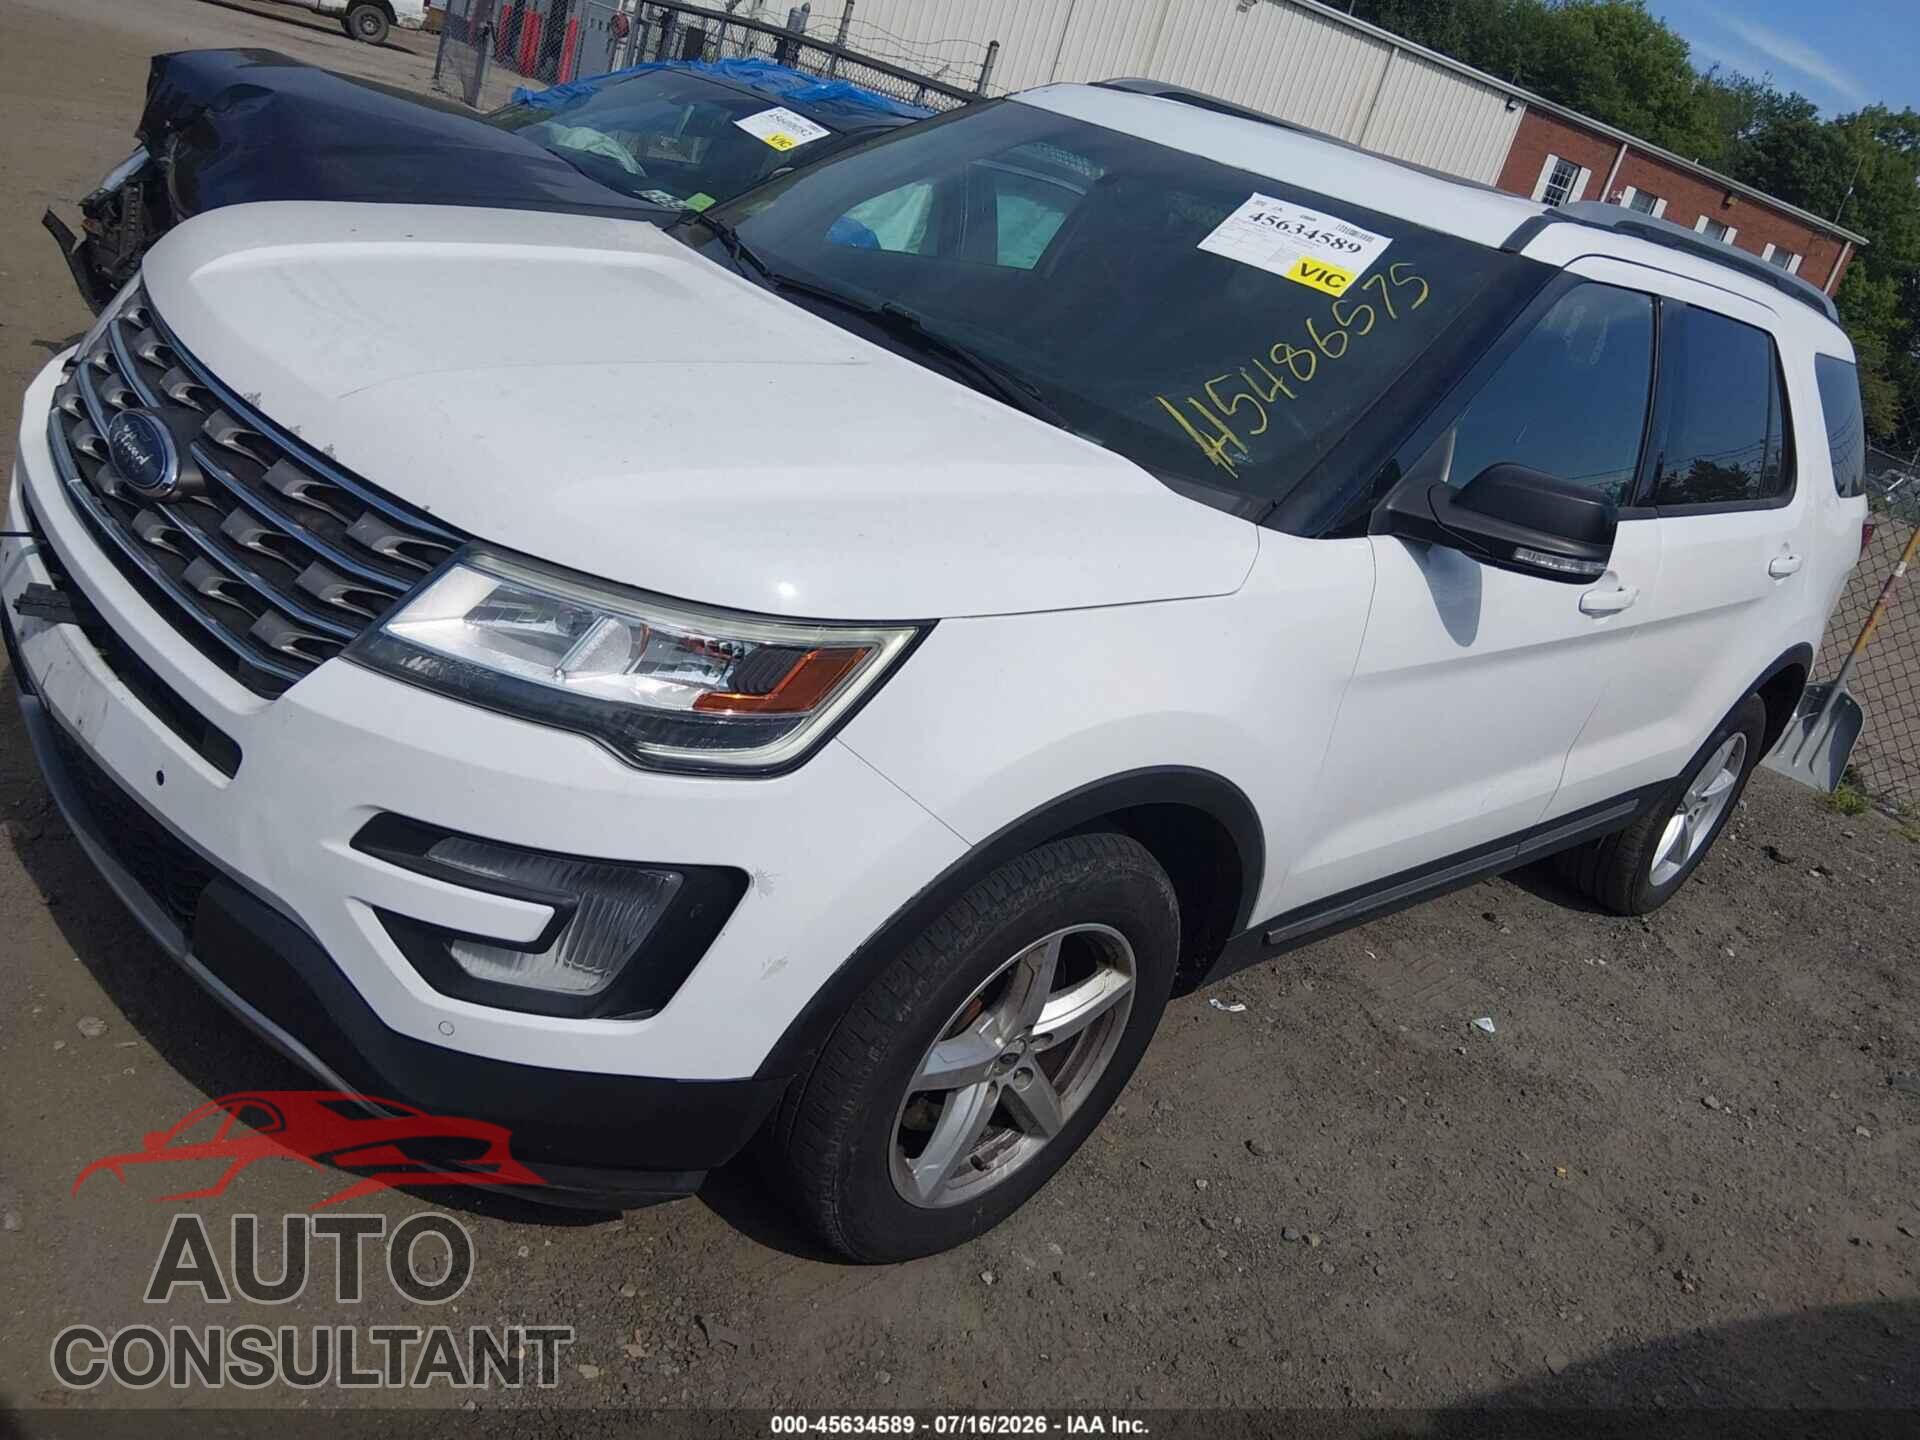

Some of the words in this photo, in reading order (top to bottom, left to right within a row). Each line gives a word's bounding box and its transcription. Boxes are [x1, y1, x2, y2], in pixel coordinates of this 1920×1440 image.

[771, 135, 793, 148] VIC
[1249, 212, 1362, 253] 45634589
[1300, 262, 1347, 288] VIC
[113, 424, 151, 465] Ford
